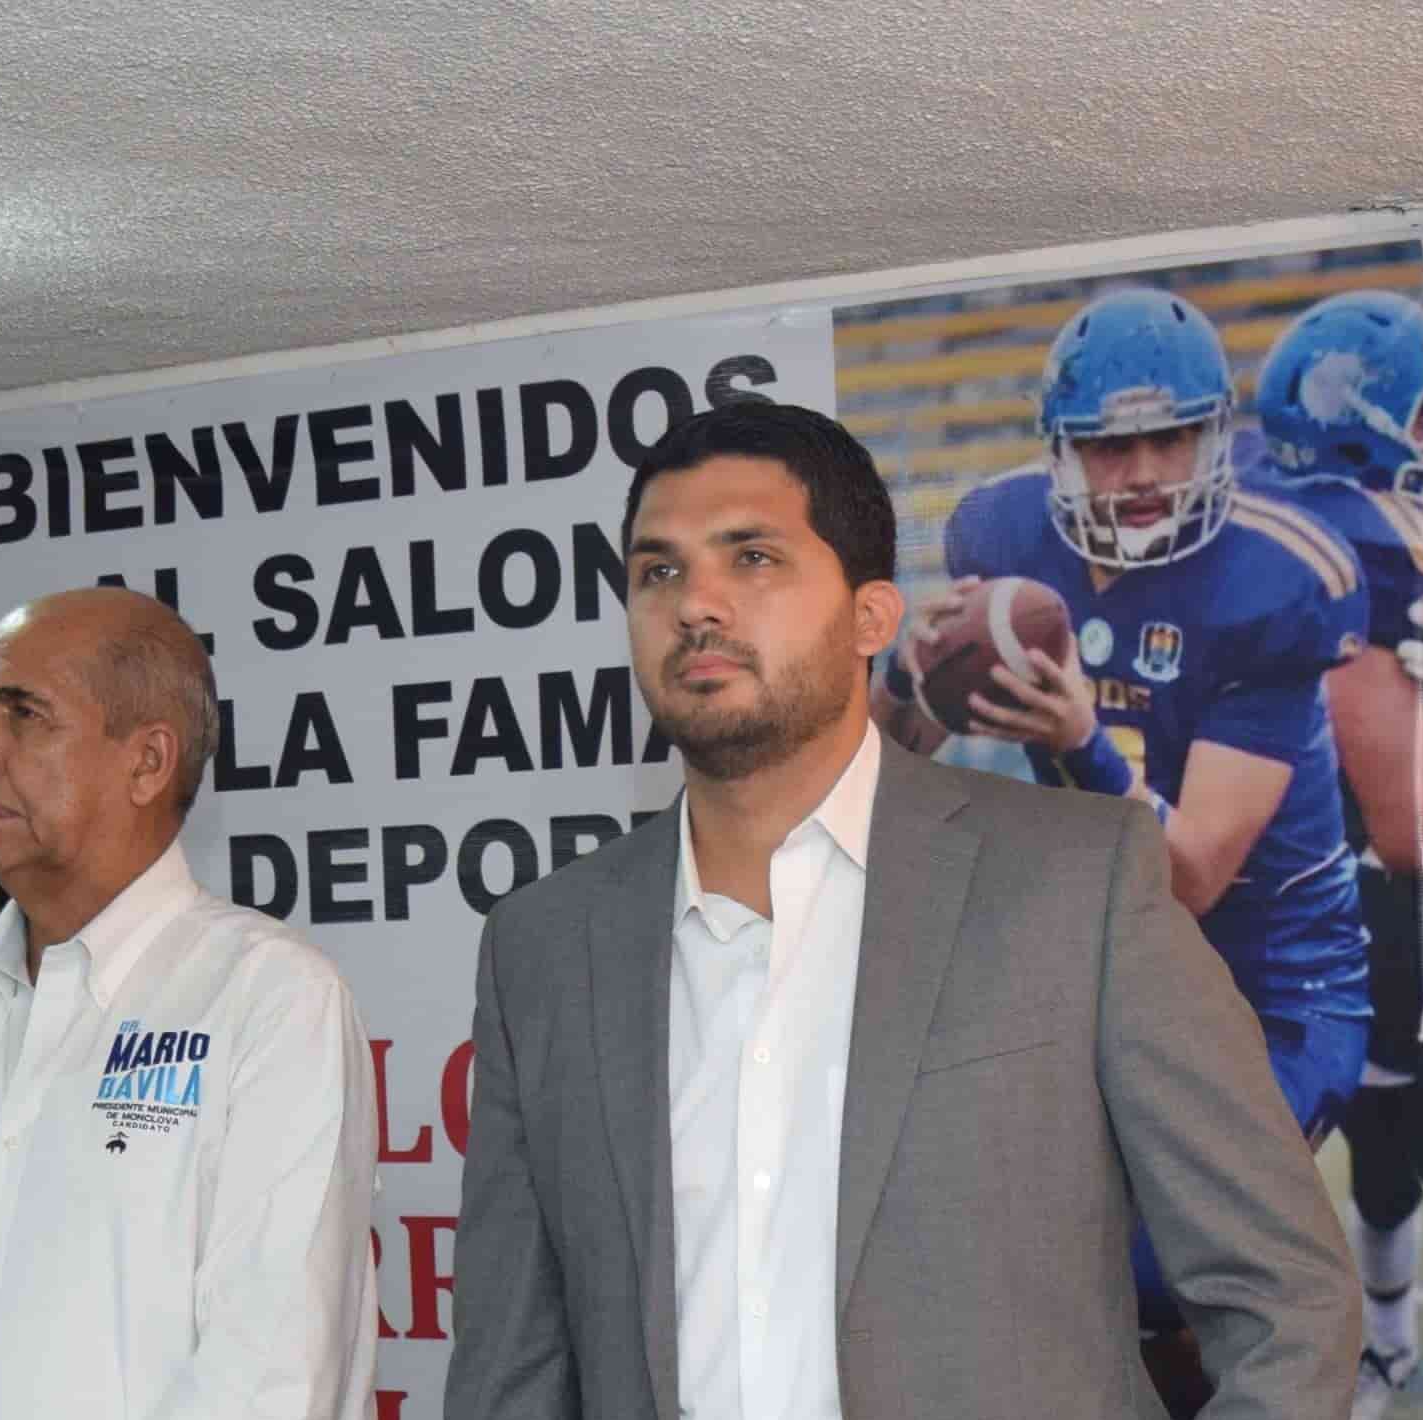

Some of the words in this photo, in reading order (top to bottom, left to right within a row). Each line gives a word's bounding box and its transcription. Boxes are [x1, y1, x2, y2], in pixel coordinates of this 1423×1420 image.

[253, 522, 628, 650] SALON
[214, 691, 354, 792] LA
[229, 810, 663, 924] DEPO
[104, 1030, 210, 1075] MARIO
